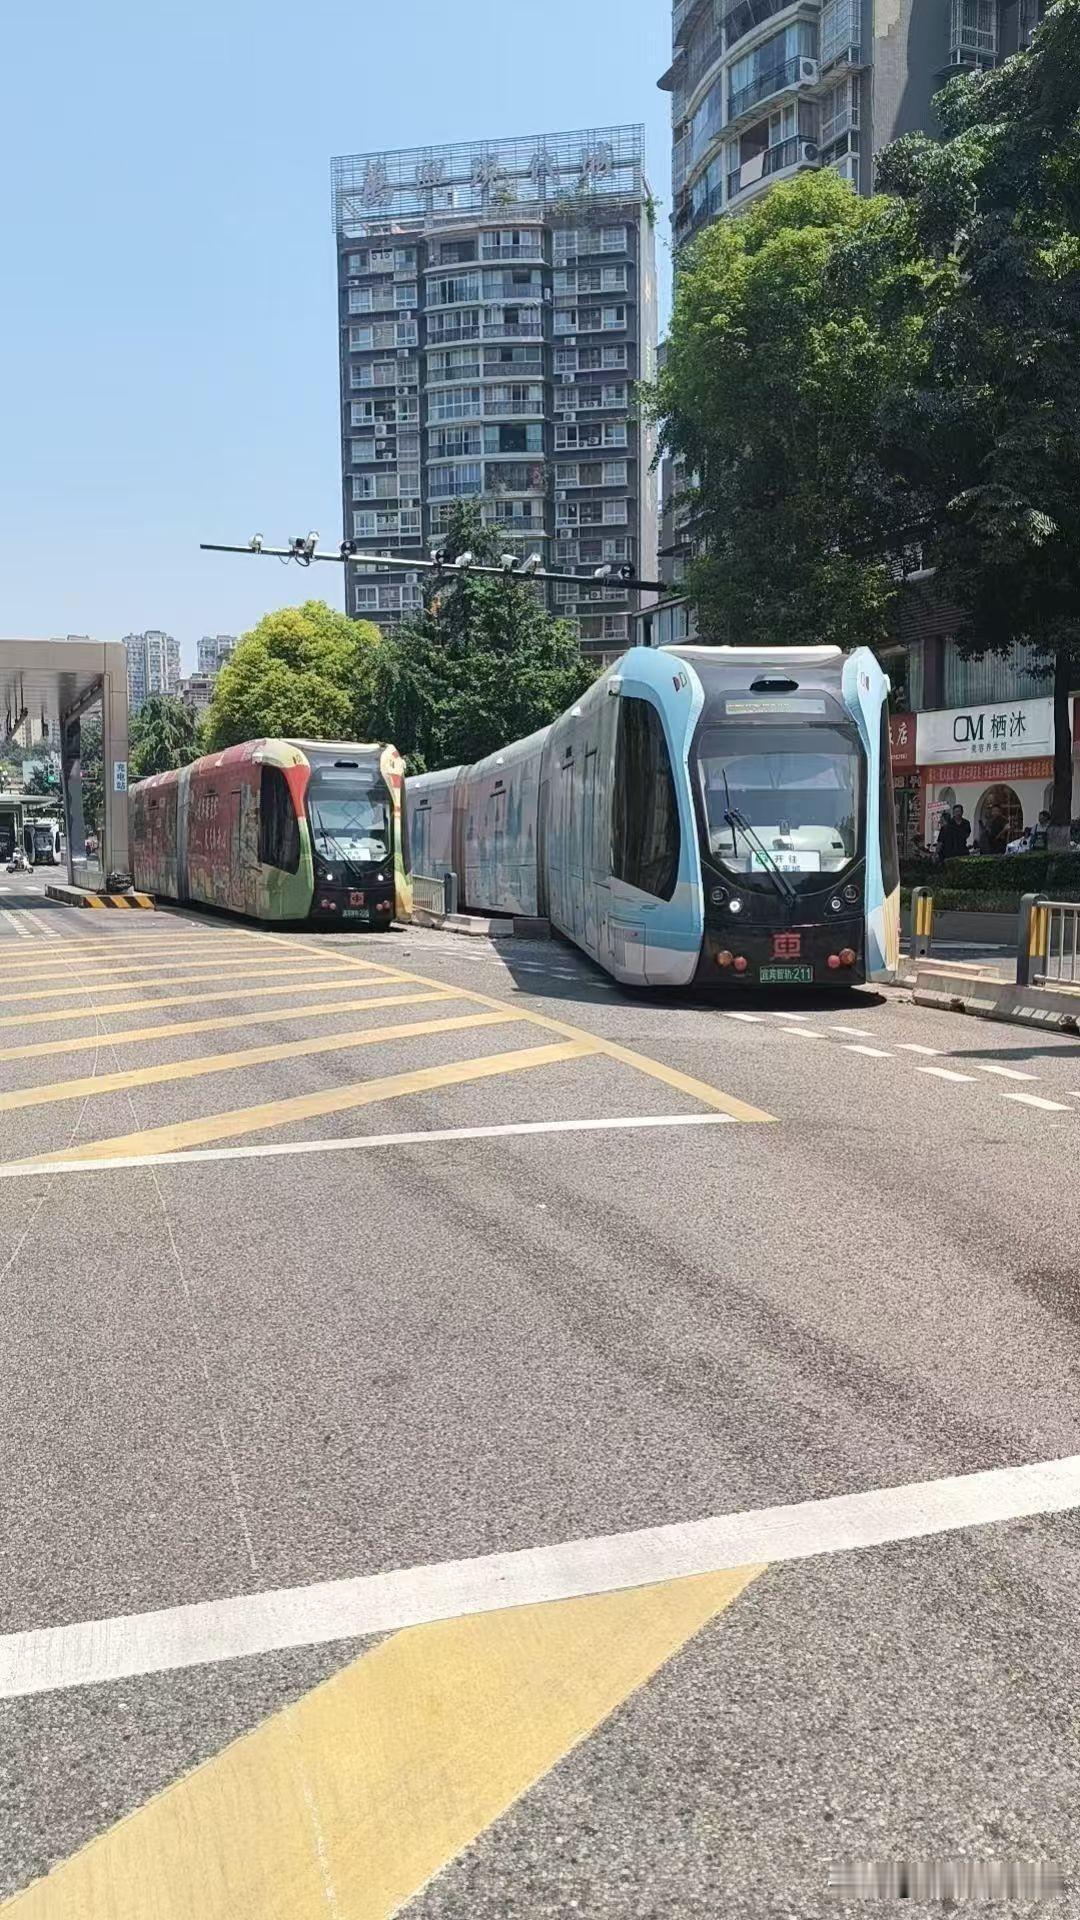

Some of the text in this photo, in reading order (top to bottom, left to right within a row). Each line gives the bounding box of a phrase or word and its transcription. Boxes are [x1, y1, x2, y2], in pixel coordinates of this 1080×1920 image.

[990, 711, 1026, 738] 栖沐
[116, 763, 126, 790] 充电站
